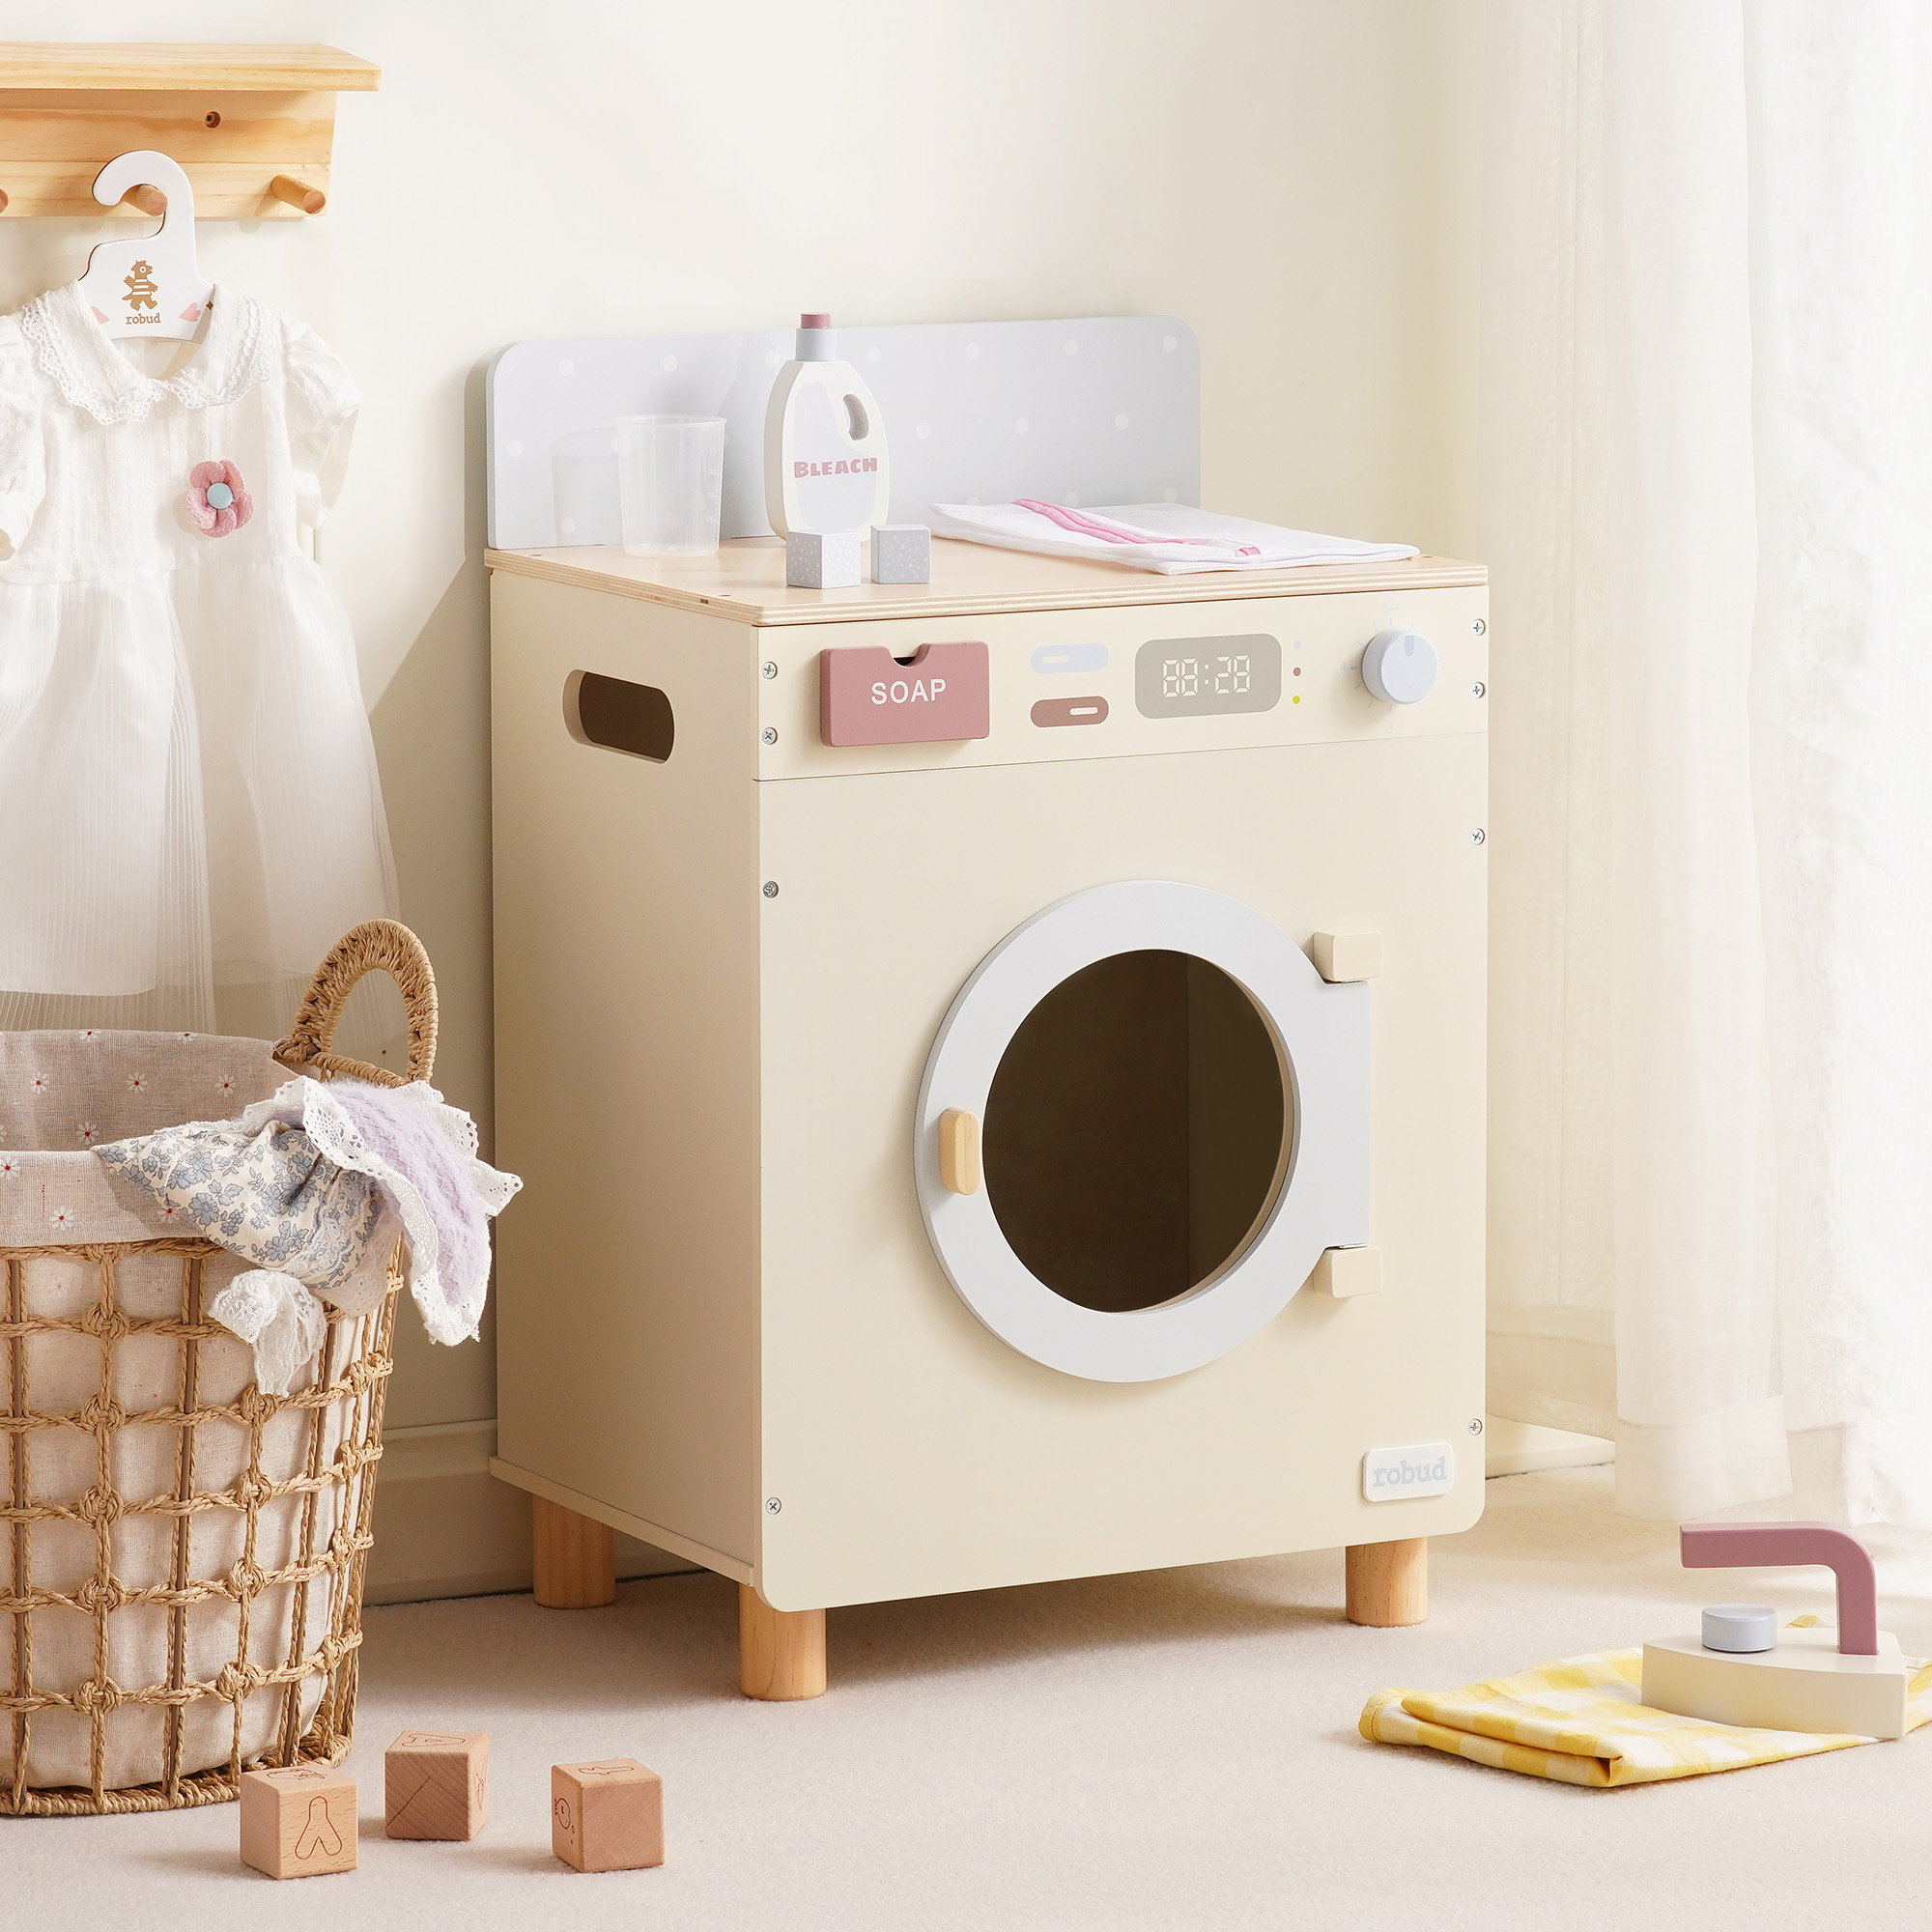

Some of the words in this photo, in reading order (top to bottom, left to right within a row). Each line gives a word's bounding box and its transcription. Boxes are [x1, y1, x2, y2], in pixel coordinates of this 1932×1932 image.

[126, 313, 161, 325] robud
[794, 458, 877, 478] BLEACH
[1162, 655, 1251, 697] 88:28
[870, 678, 947, 705] SOAP
[1373, 1455, 1447, 1488] robud
